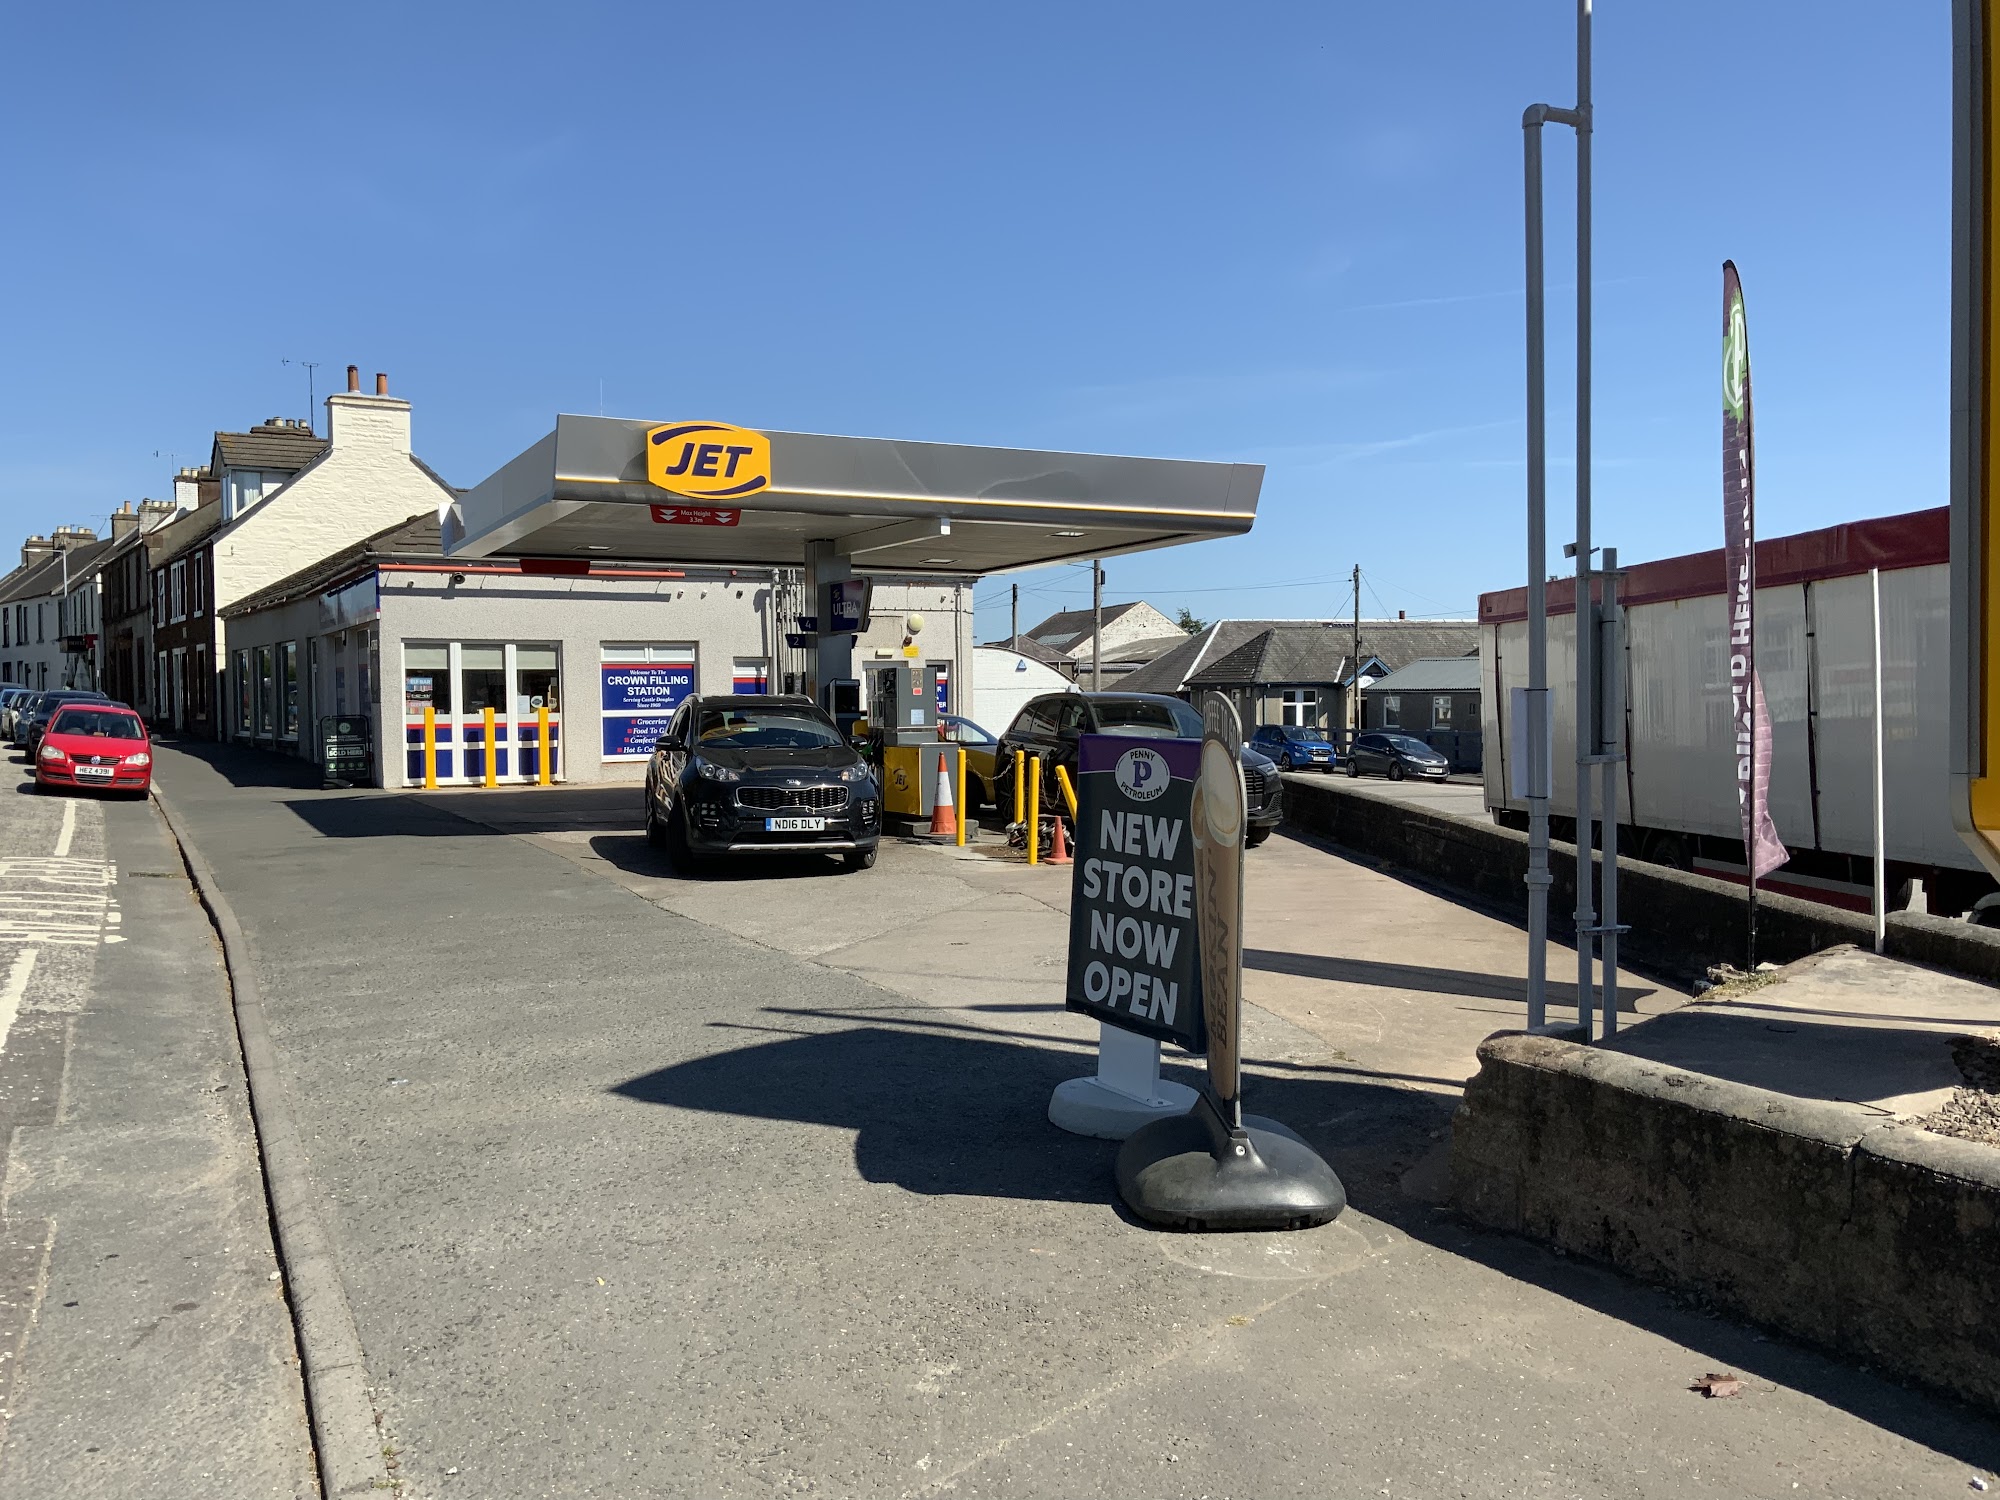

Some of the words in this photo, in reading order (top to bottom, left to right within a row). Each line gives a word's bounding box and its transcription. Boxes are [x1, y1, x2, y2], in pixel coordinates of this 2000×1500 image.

[665, 442, 753, 478] JET
[833, 601, 858, 616] ULTRA
[804, 620, 812, 629] 4
[793, 637, 800, 646] 2
[607, 676, 647, 685] CROWN
[650, 676, 688, 685] FILLING
[627, 686, 670, 696] STATION
[1130, 750, 1155, 761] PENNY
[895, 774, 907, 785] JET
[1120, 781, 1163, 799] PETROLEUM
[775, 819, 798, 829] ND16
[801, 819, 821, 829] DLY
[1100, 809, 1183, 861] NEW
[1083, 857, 1193, 919] STORE
[1090, 909, 1180, 970] NOW
[1217, 912, 1229, 1050] BEAN
[1084, 961, 1178, 1026] OPEN
